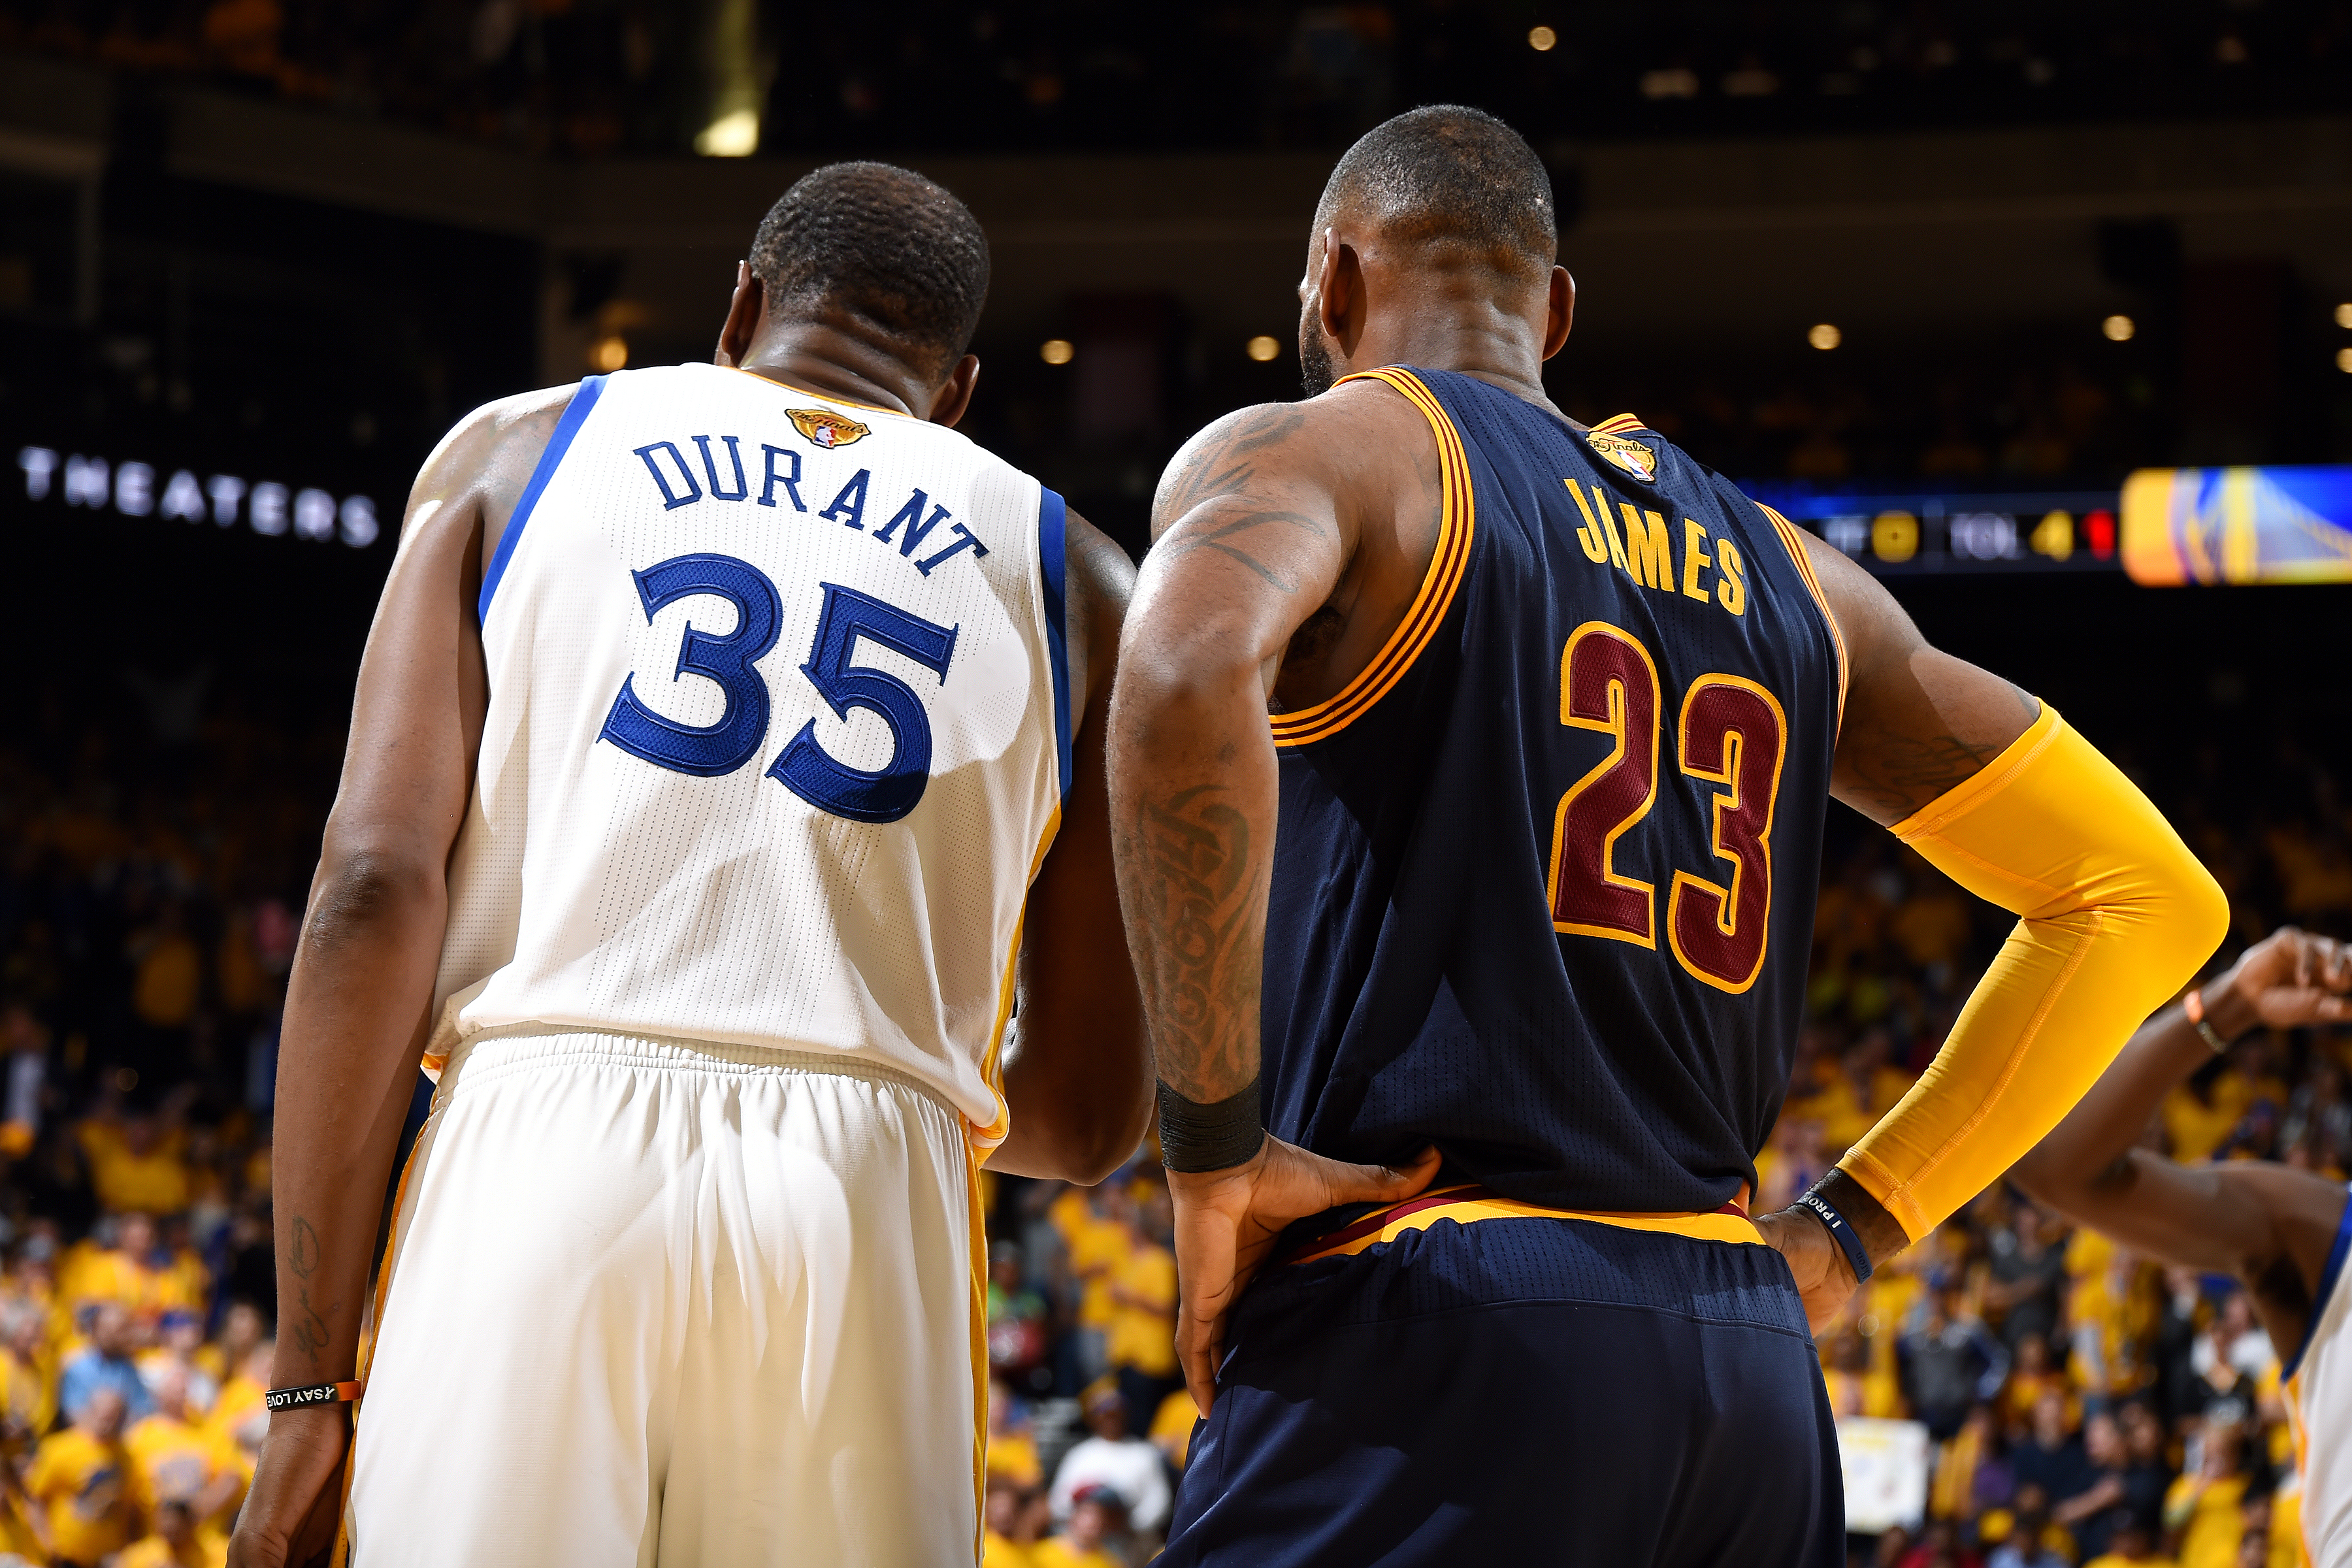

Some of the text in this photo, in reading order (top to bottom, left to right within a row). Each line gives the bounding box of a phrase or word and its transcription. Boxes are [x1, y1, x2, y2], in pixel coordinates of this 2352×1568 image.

[18, 446, 379, 547] THEATERS
[633, 435, 990, 578] DURANT
[1563, 478, 1746, 615] JAMES
[2031, 510, 2073, 562] 4
[595, 553, 959, 823] 35
[1547, 621, 1788, 994] 23
[1831, 1220, 1842, 1228] I
[267, 1388, 323, 1407] SAY LOVE
